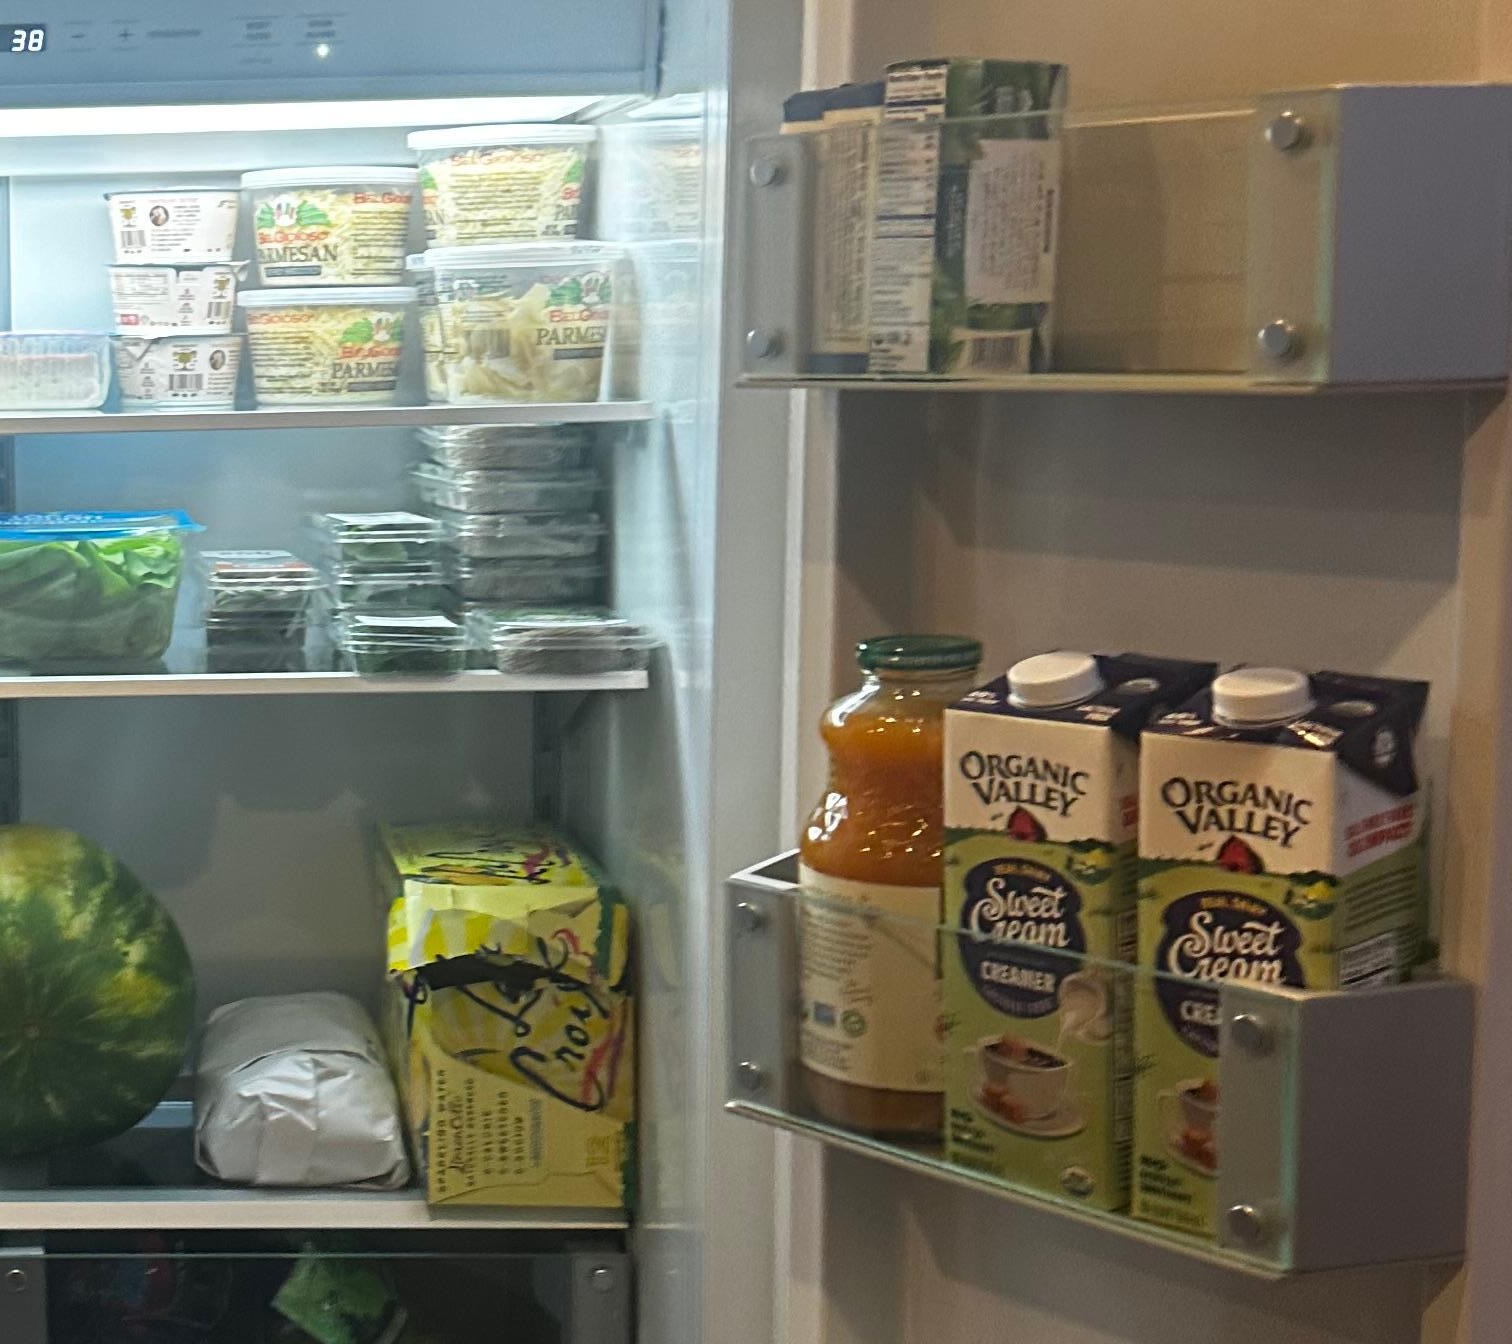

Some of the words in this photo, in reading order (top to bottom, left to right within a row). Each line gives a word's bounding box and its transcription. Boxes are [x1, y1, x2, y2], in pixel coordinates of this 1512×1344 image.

[10, 29, 45, 53] 38
[960, 750, 1090, 795] ORGANIC
[971, 778, 1078, 817] VALLEY
[1160, 776, 1313, 825] ORGANIC
[1174, 806, 1300, 847] VALLEY
[981, 877, 1068, 921] Sweet
[970, 898, 1070, 948] Cream
[1183, 911, 1285, 957] Sweet
[980, 960, 1056, 993] CREAMER
[1167, 933, 1286, 985] Cream
